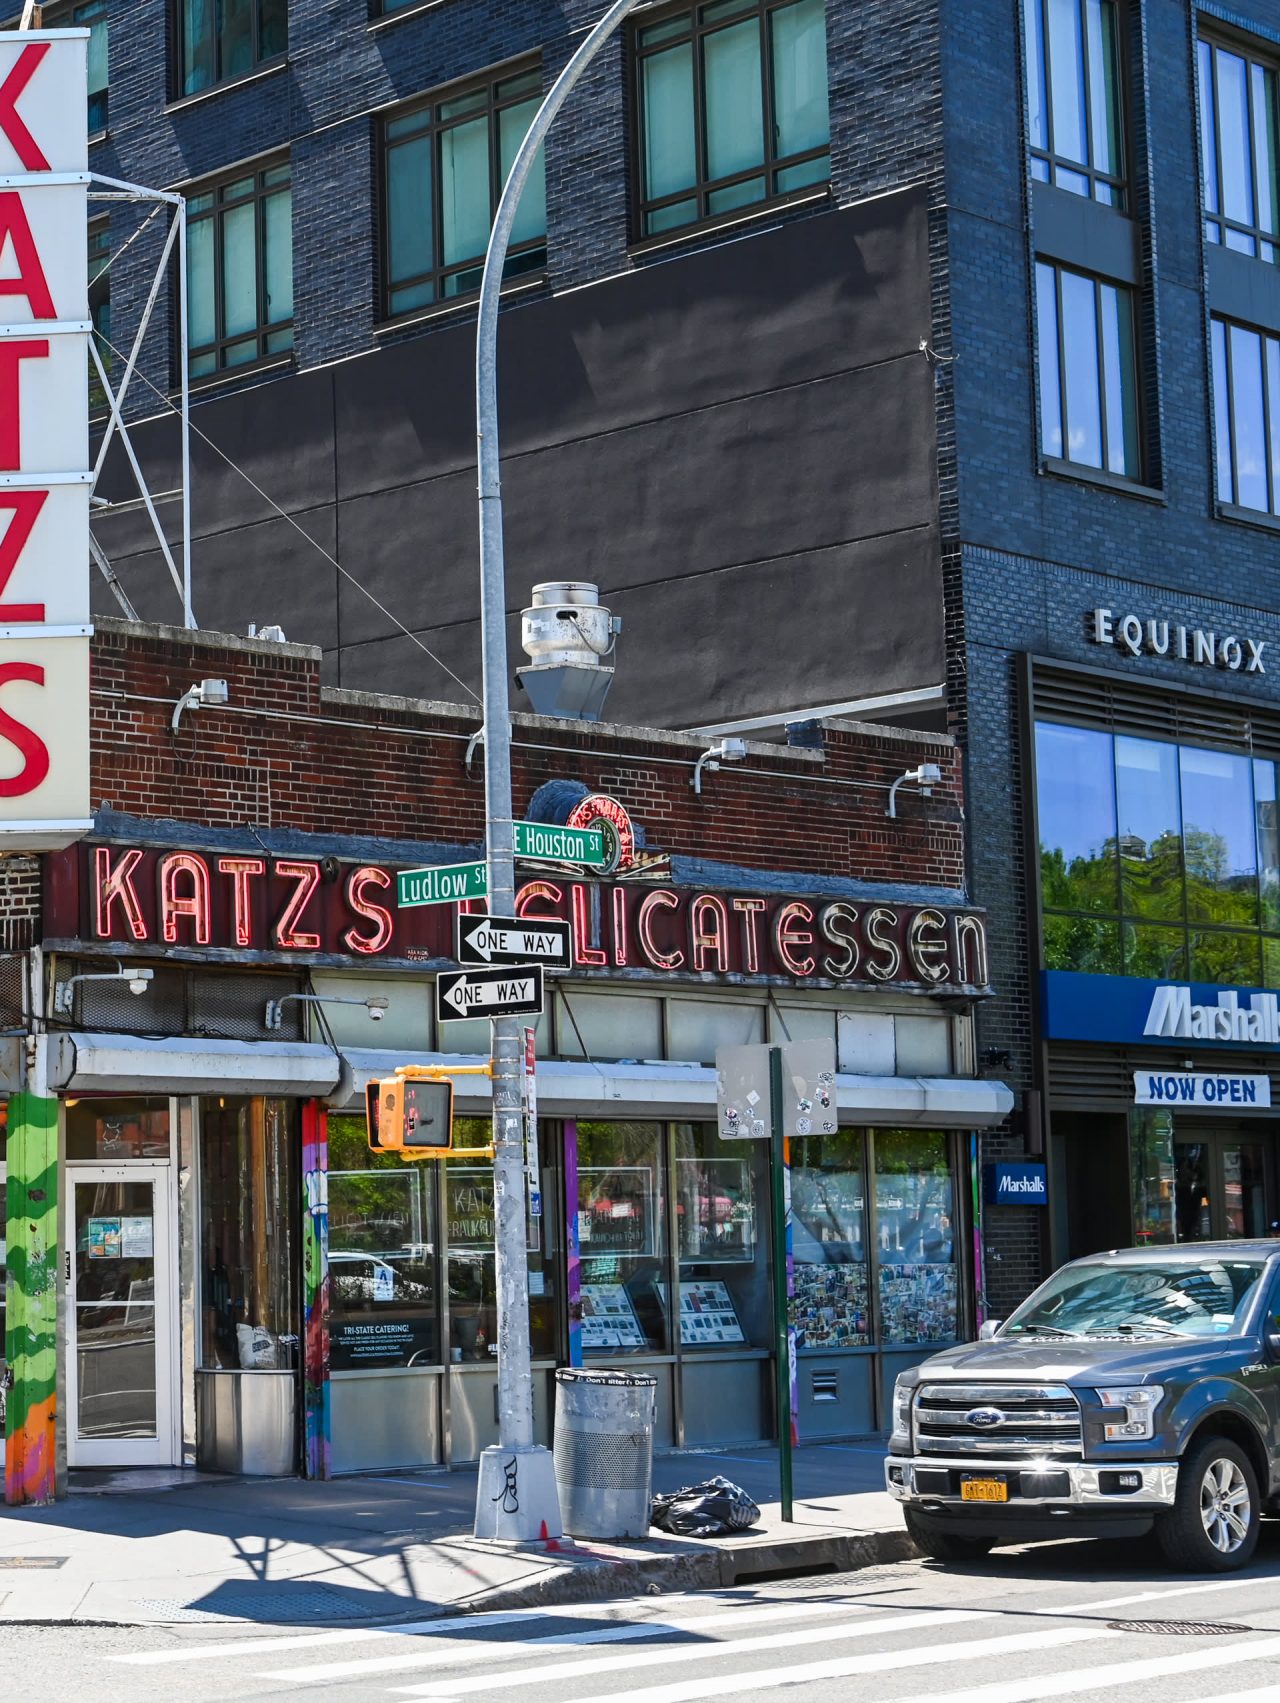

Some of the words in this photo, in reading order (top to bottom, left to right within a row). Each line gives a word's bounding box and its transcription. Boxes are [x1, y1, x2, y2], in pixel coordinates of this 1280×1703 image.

[1094, 608, 1266, 673] EQUINOX
[514, 826, 520, 851] E
[527, 828, 584, 859] Houston
[589, 834, 599, 851] St
[401, 870, 468, 903] Ludlow
[475, 867, 486, 884] St
[458, 880, 989, 986] ELICATESSEN
[477, 931, 508, 950] ONE
[523, 934, 556, 954] WAY
[454, 985, 483, 1005] ONE
[497, 981, 528, 1002] WAY
[1143, 985, 1280, 1043] Marshall
[1148, 1076, 1196, 1101] NOW
[1202, 1078, 1256, 1102] OPEN
[999, 1175, 1044, 1192] Marshalls
[344, 1326, 374, 1334] TRI-STATE
[375, 1324, 410, 1333] CATERING!
[586, 1376, 606, 1385] Don't
